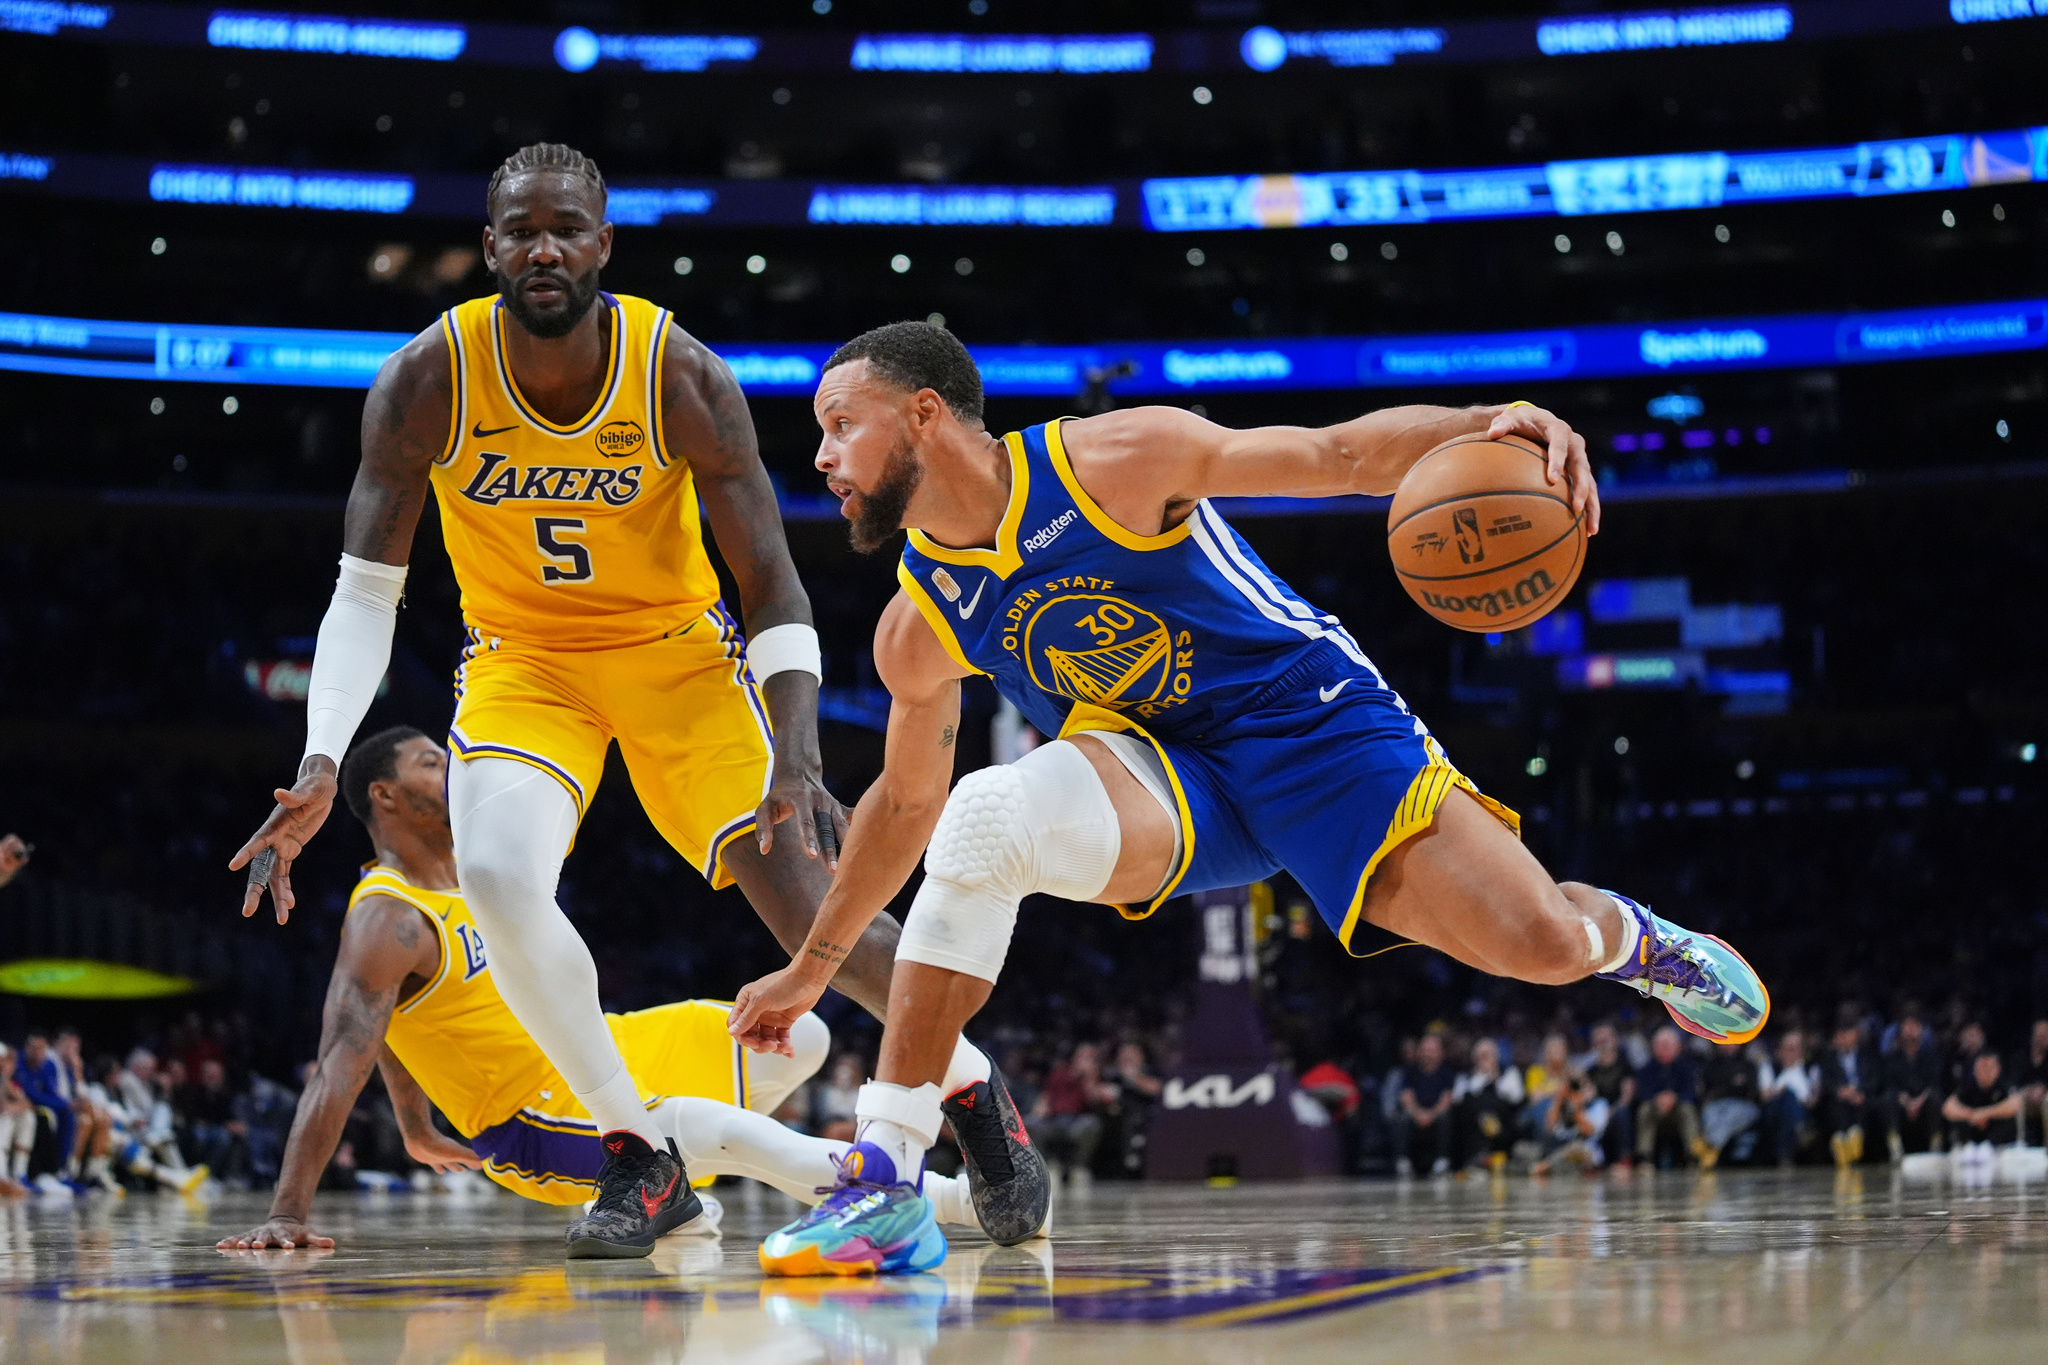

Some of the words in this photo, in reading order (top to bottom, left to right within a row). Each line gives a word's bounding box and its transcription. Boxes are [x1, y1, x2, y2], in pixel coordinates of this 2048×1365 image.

[600, 431, 641, 446] bibigo
[458, 452, 643, 506] LAKERS
[532, 516, 595, 586] 5
[1023, 509, 1078, 553] Rakuten
[1420, 568, 1556, 616] Wilson
[1002, 588, 1042, 661] OLDEN
[1045, 575, 1115, 592] STATE
[1075, 603, 1135, 646] 30
